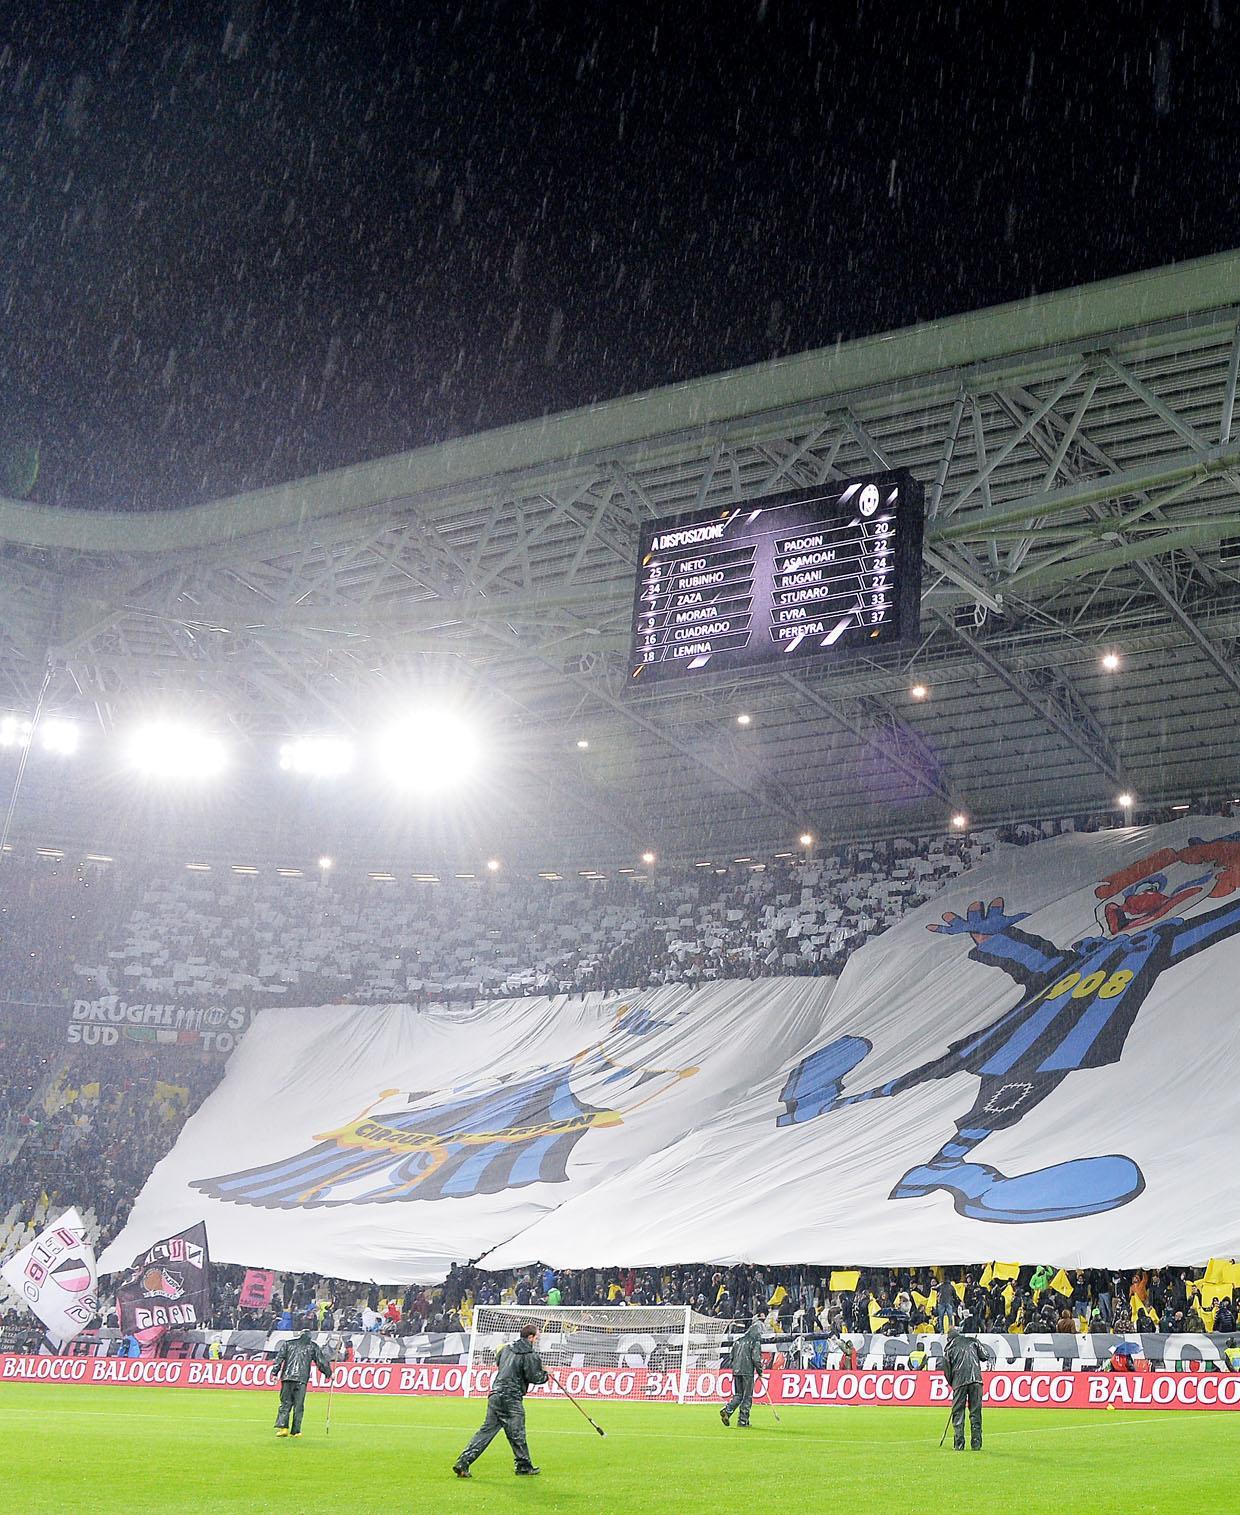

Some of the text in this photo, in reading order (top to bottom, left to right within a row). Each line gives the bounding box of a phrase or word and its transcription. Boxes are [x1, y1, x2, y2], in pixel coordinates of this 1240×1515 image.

[651, 523, 725, 551] A DISPOSIZIONE
[784, 523, 889, 552] PADOIN 20
[649, 558, 707, 579] 25 NETO
[782, 540, 888, 571] ASAMOAH 22
[648, 571, 725, 595] 34 RUBINHO
[781, 557, 887, 587] RUGANI 24
[649, 592, 703, 611] 7 ZAZA
[780, 575, 886, 604] STURARO 27
[648, 606, 718, 628] 9 MORATA
[779, 593, 885, 621] EVRA 33
[644, 621, 730, 646] 16 CUADRADO
[779, 611, 885, 639] PEREYRA 37
[643, 641, 712, 663] 18 LEMINA
[72, 999, 176, 1025] DRUGHI
[67, 1024, 119, 1046] SUD
[2, 1357, 88, 1379] BALOCCO
[92, 1359, 183, 1383] BALOCCO
[308, 1366, 392, 1389] ALOCCO
[400, 1367, 498, 1393] BALOCC
[527, 1370, 636, 1396] ALOCCO
[645, 1372, 772, 1399] BALOCO
[782, 1373, 917, 1400] BALOCCO
[929, 1374, 1077, 1402] BOCCO
